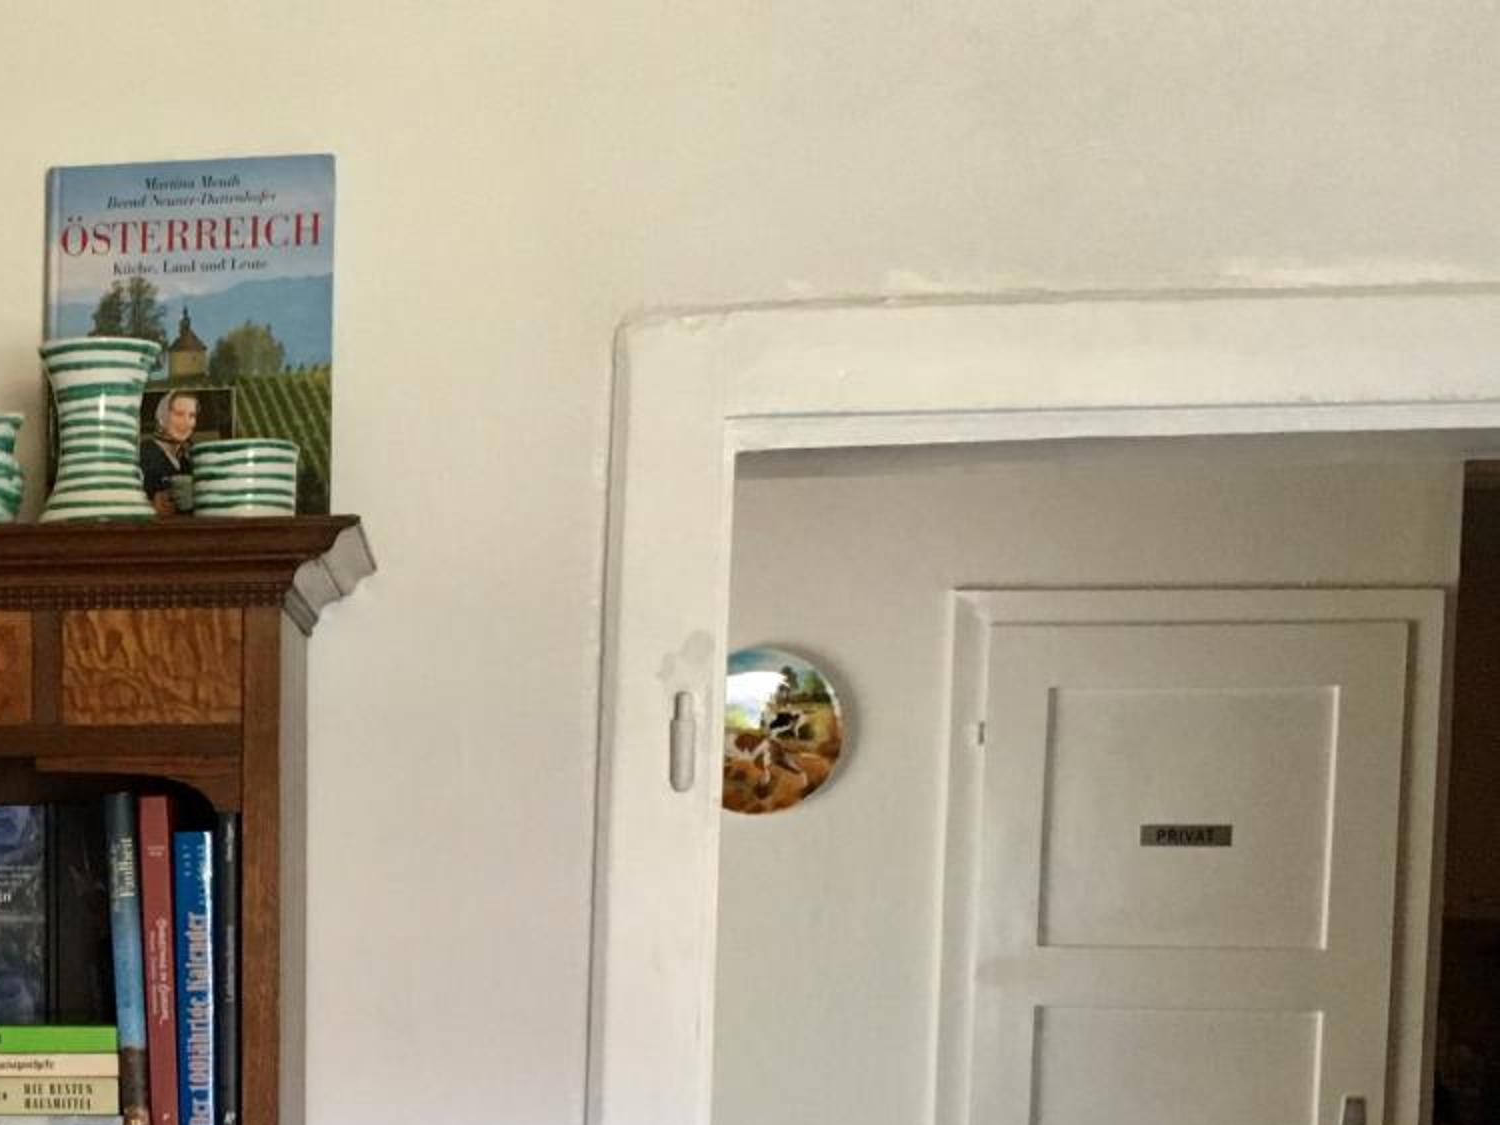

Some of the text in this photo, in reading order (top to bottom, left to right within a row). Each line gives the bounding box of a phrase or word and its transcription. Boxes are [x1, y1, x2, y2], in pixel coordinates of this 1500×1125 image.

[60, 212, 321, 257] ÖSTERREICH
[162, 258, 196, 274] Land
[201, 257, 227, 272] und
[231, 257, 268, 272] Leute
[1155, 828, 1216, 842] PRIVAT
[185, 911, 209, 993] Kalender
